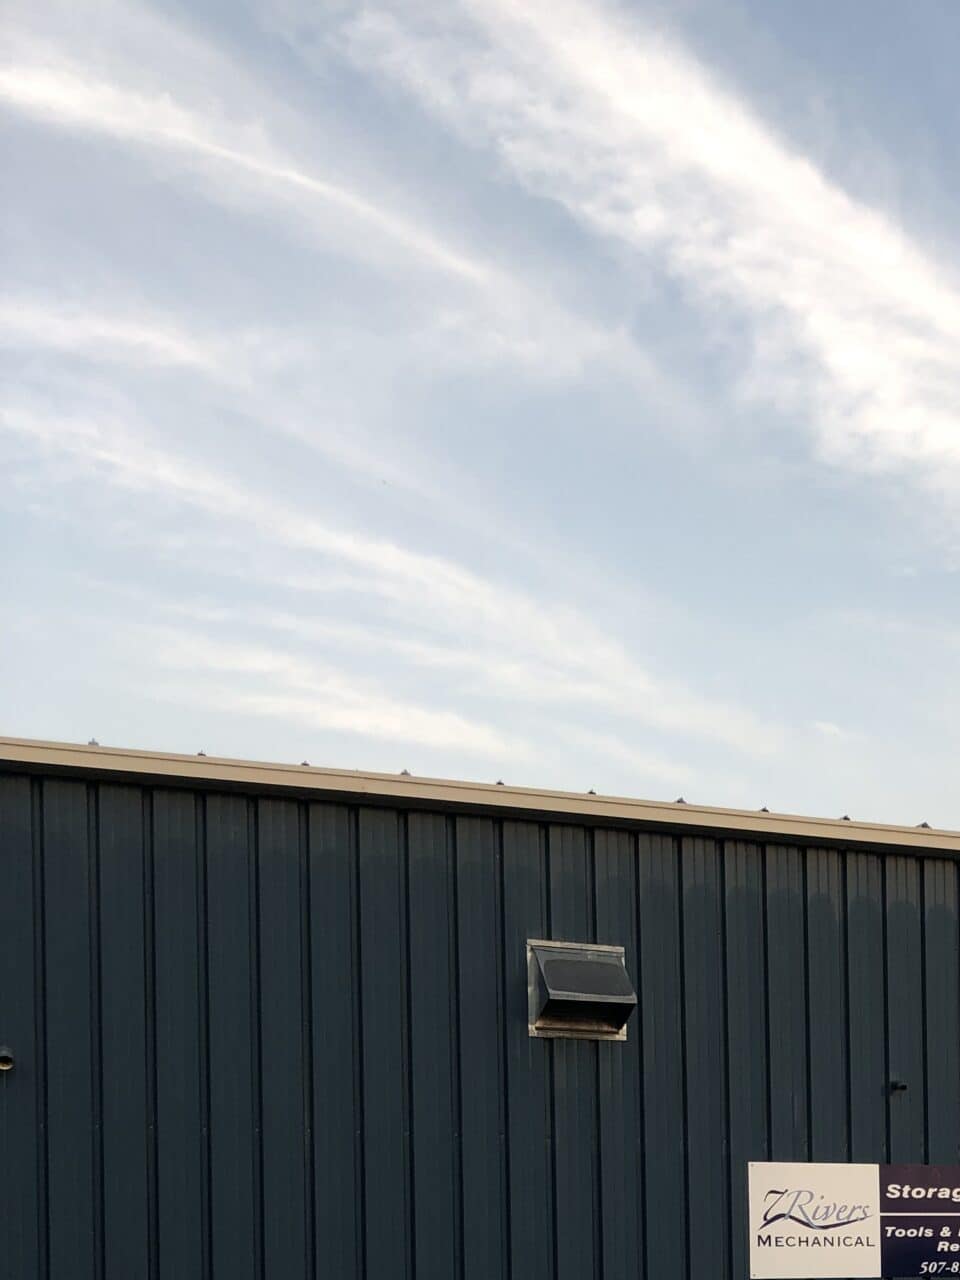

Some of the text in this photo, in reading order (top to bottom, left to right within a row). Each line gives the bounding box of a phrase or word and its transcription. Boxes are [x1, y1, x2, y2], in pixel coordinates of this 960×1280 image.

[885, 1226, 934, 1237] Tools
[939, 1226, 952, 1237] &
[757, 1234, 876, 1247] MECHANICAL
